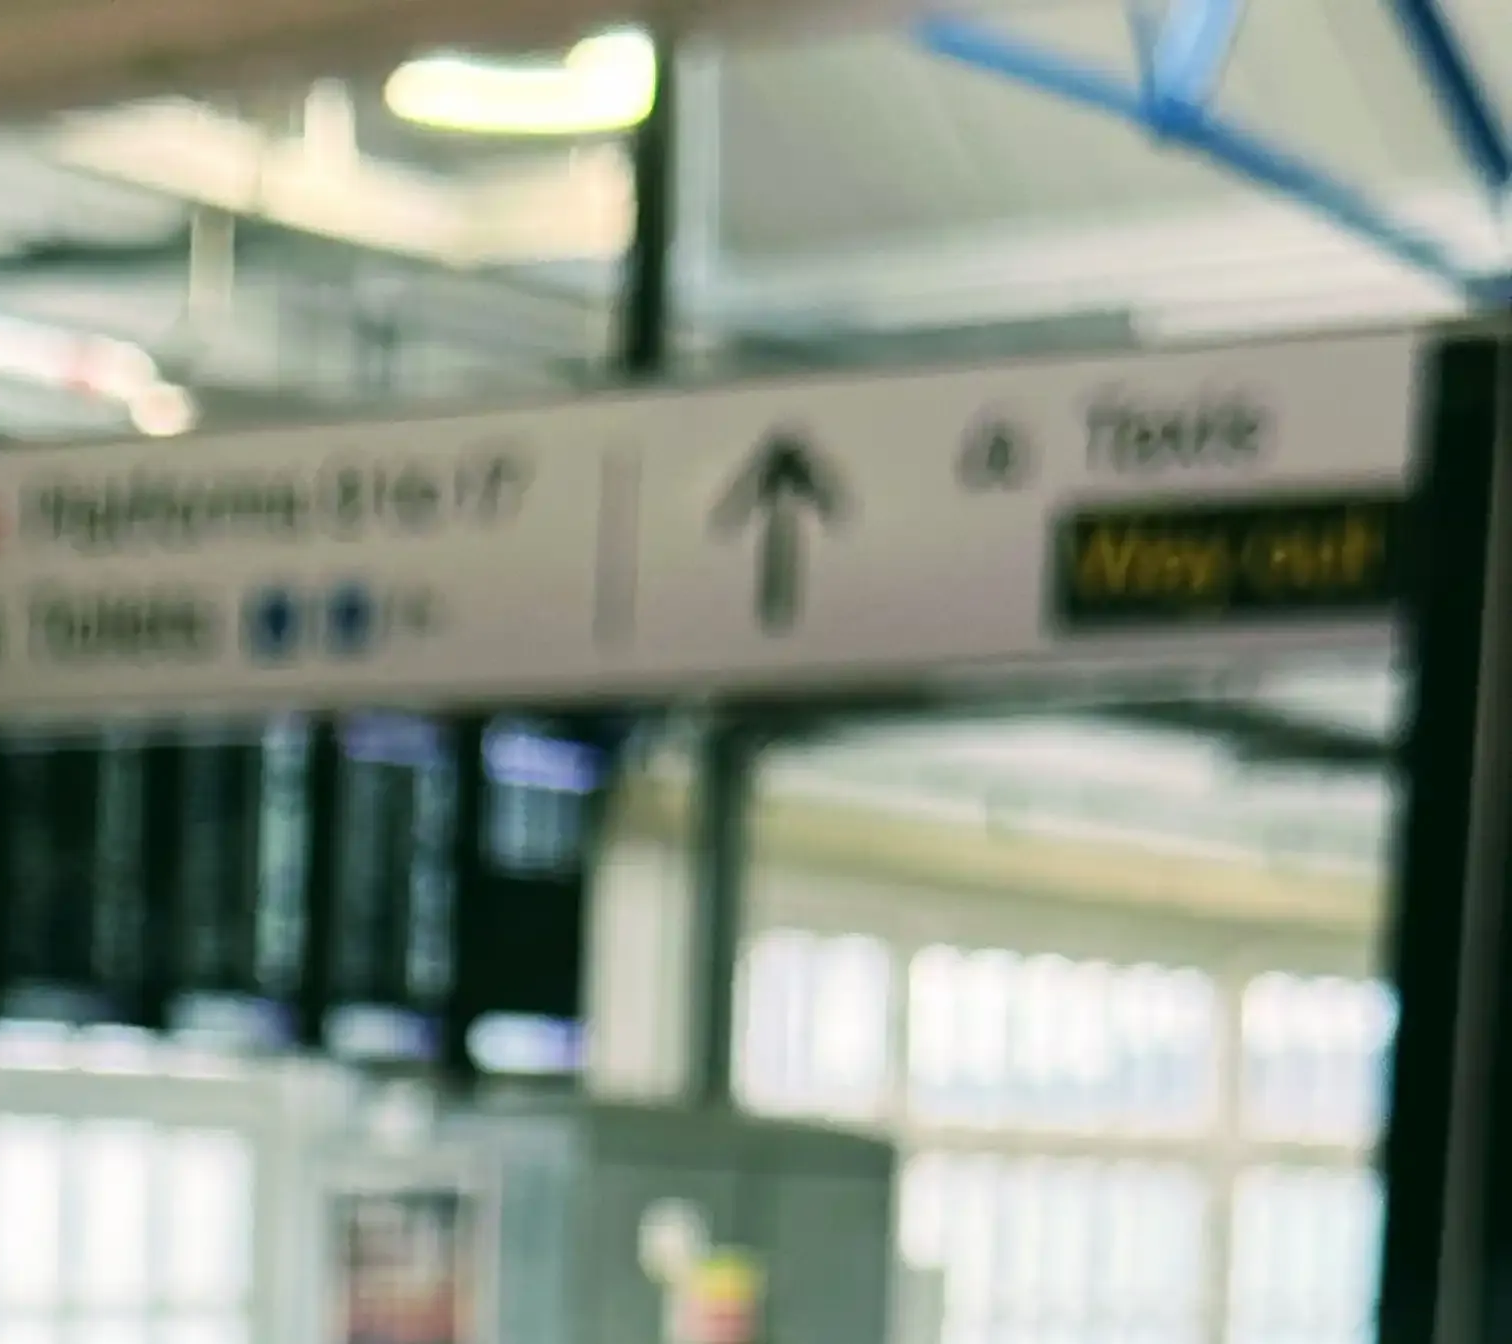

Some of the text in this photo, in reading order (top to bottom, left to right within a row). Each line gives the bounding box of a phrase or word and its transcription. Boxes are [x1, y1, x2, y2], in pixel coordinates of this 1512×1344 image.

[1082, 382, 1272, 468] Taxis
[28, 466, 314, 548] Platforms
[384, 454, 458, 526] to
[1078, 516, 1380, 604] Way out
[31, 582, 218, 668] Toilets
